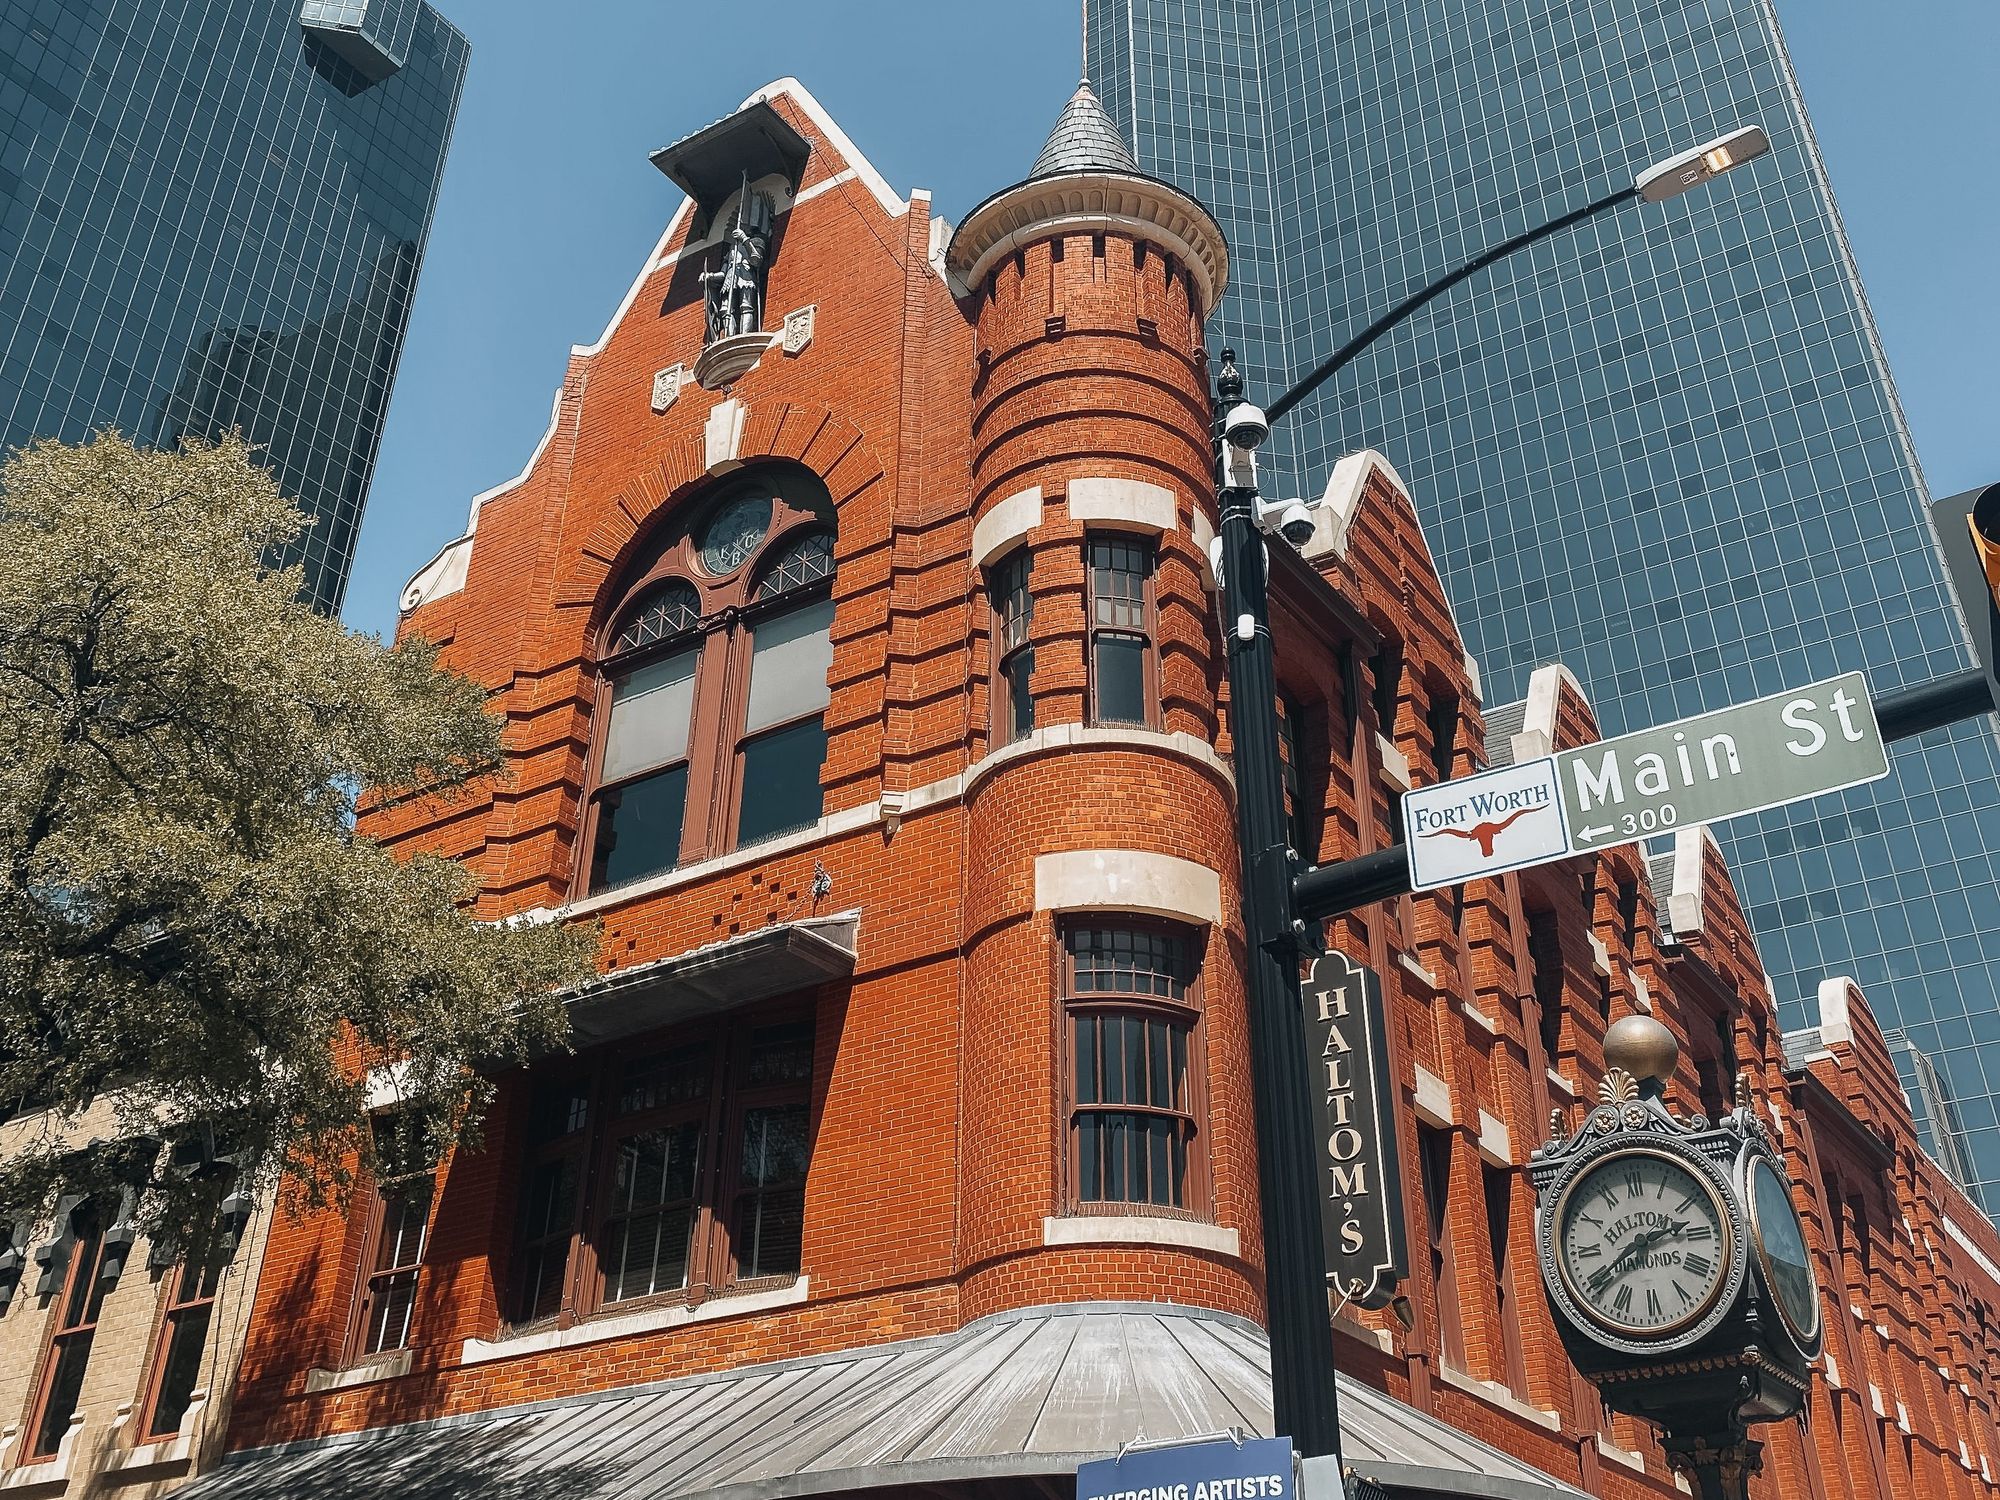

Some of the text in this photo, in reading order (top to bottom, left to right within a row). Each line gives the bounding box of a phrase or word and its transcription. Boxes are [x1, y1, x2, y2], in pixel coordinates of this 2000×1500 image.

[1572, 687, 1864, 812] Main St
[1414, 783, 1550, 832] FORT WORTH
[1620, 803, 1678, 836] 300
[1315, 986, 1369, 1255] HALTOM'S
[1614, 1250, 1682, 1273] DIAMONDS
[1193, 1474, 1283, 1500] ARTISTS
